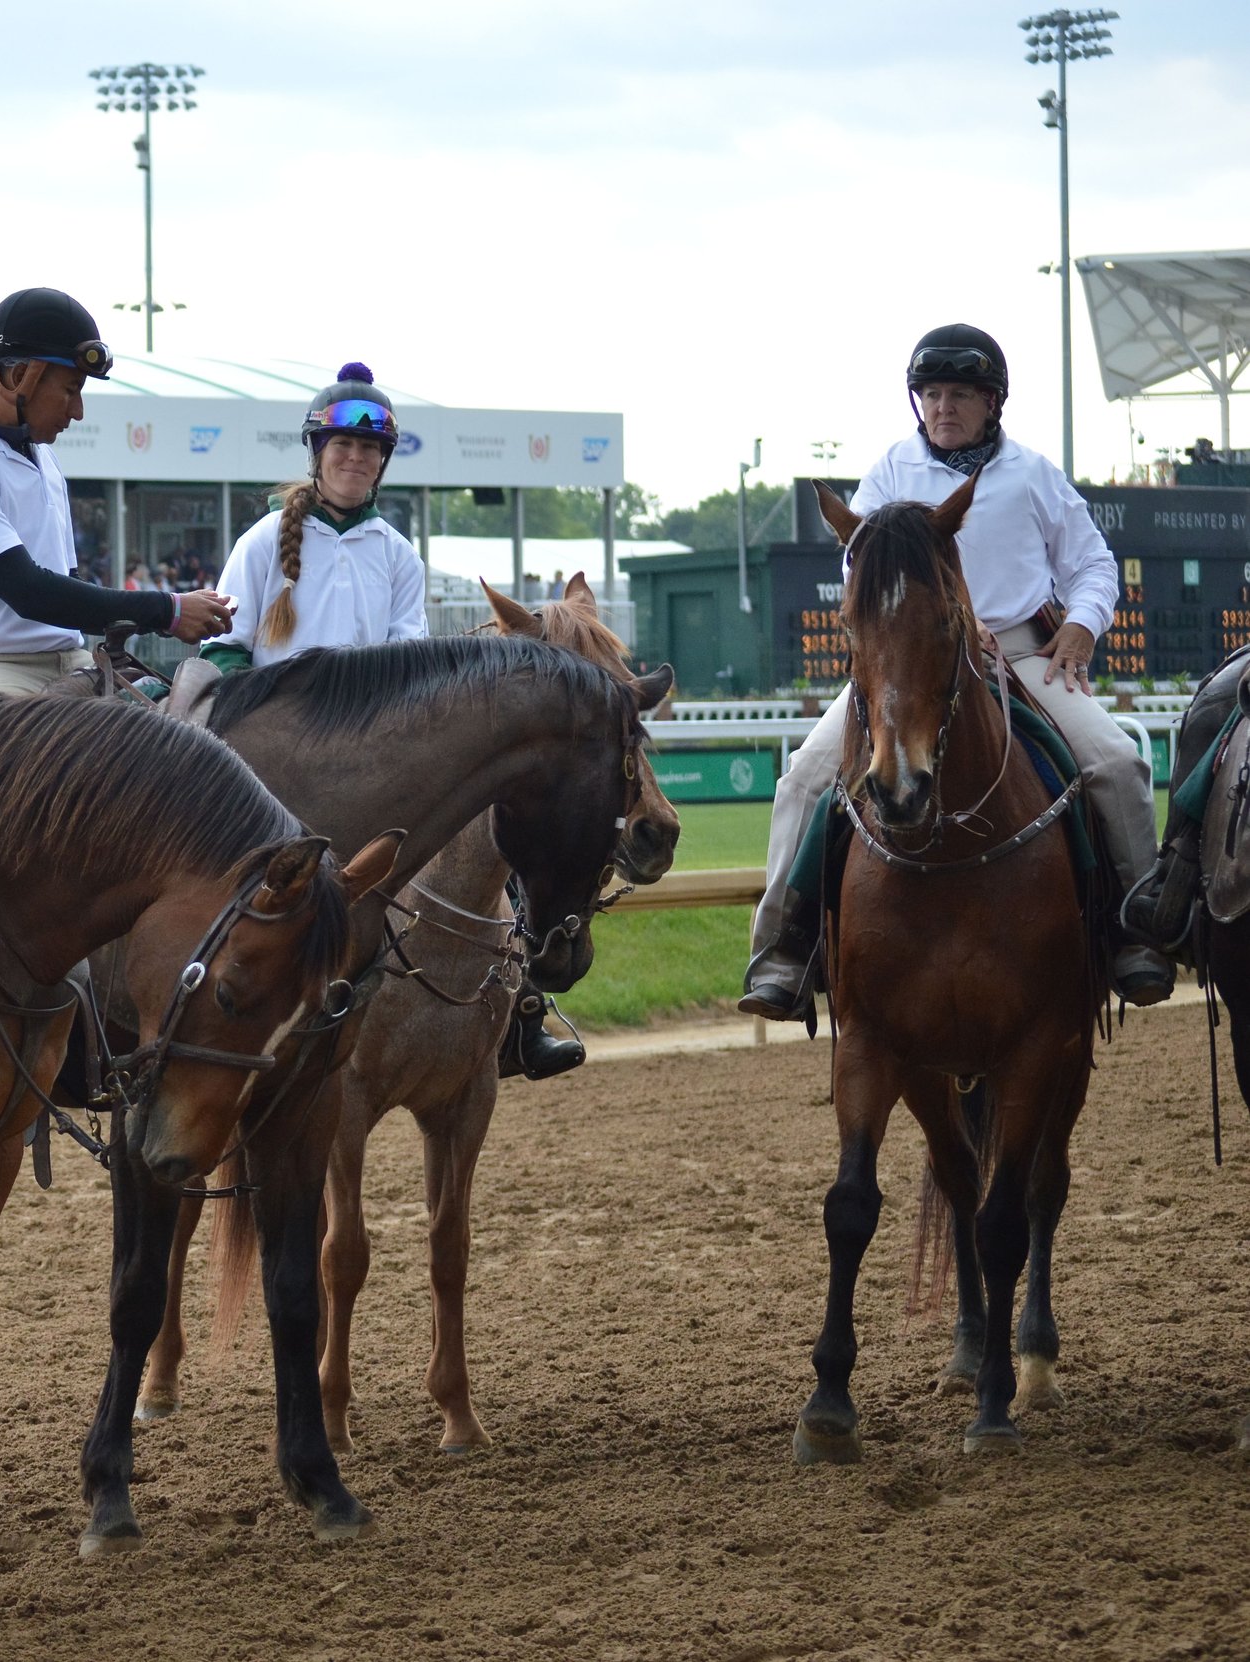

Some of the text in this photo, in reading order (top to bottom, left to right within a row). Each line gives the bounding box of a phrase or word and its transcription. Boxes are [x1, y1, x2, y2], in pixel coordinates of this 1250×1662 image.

[1089, 502, 1126, 535] RBY
[1154, 511, 1247, 530] PRESENTED BY
[816, 583, 845, 602] TOT
